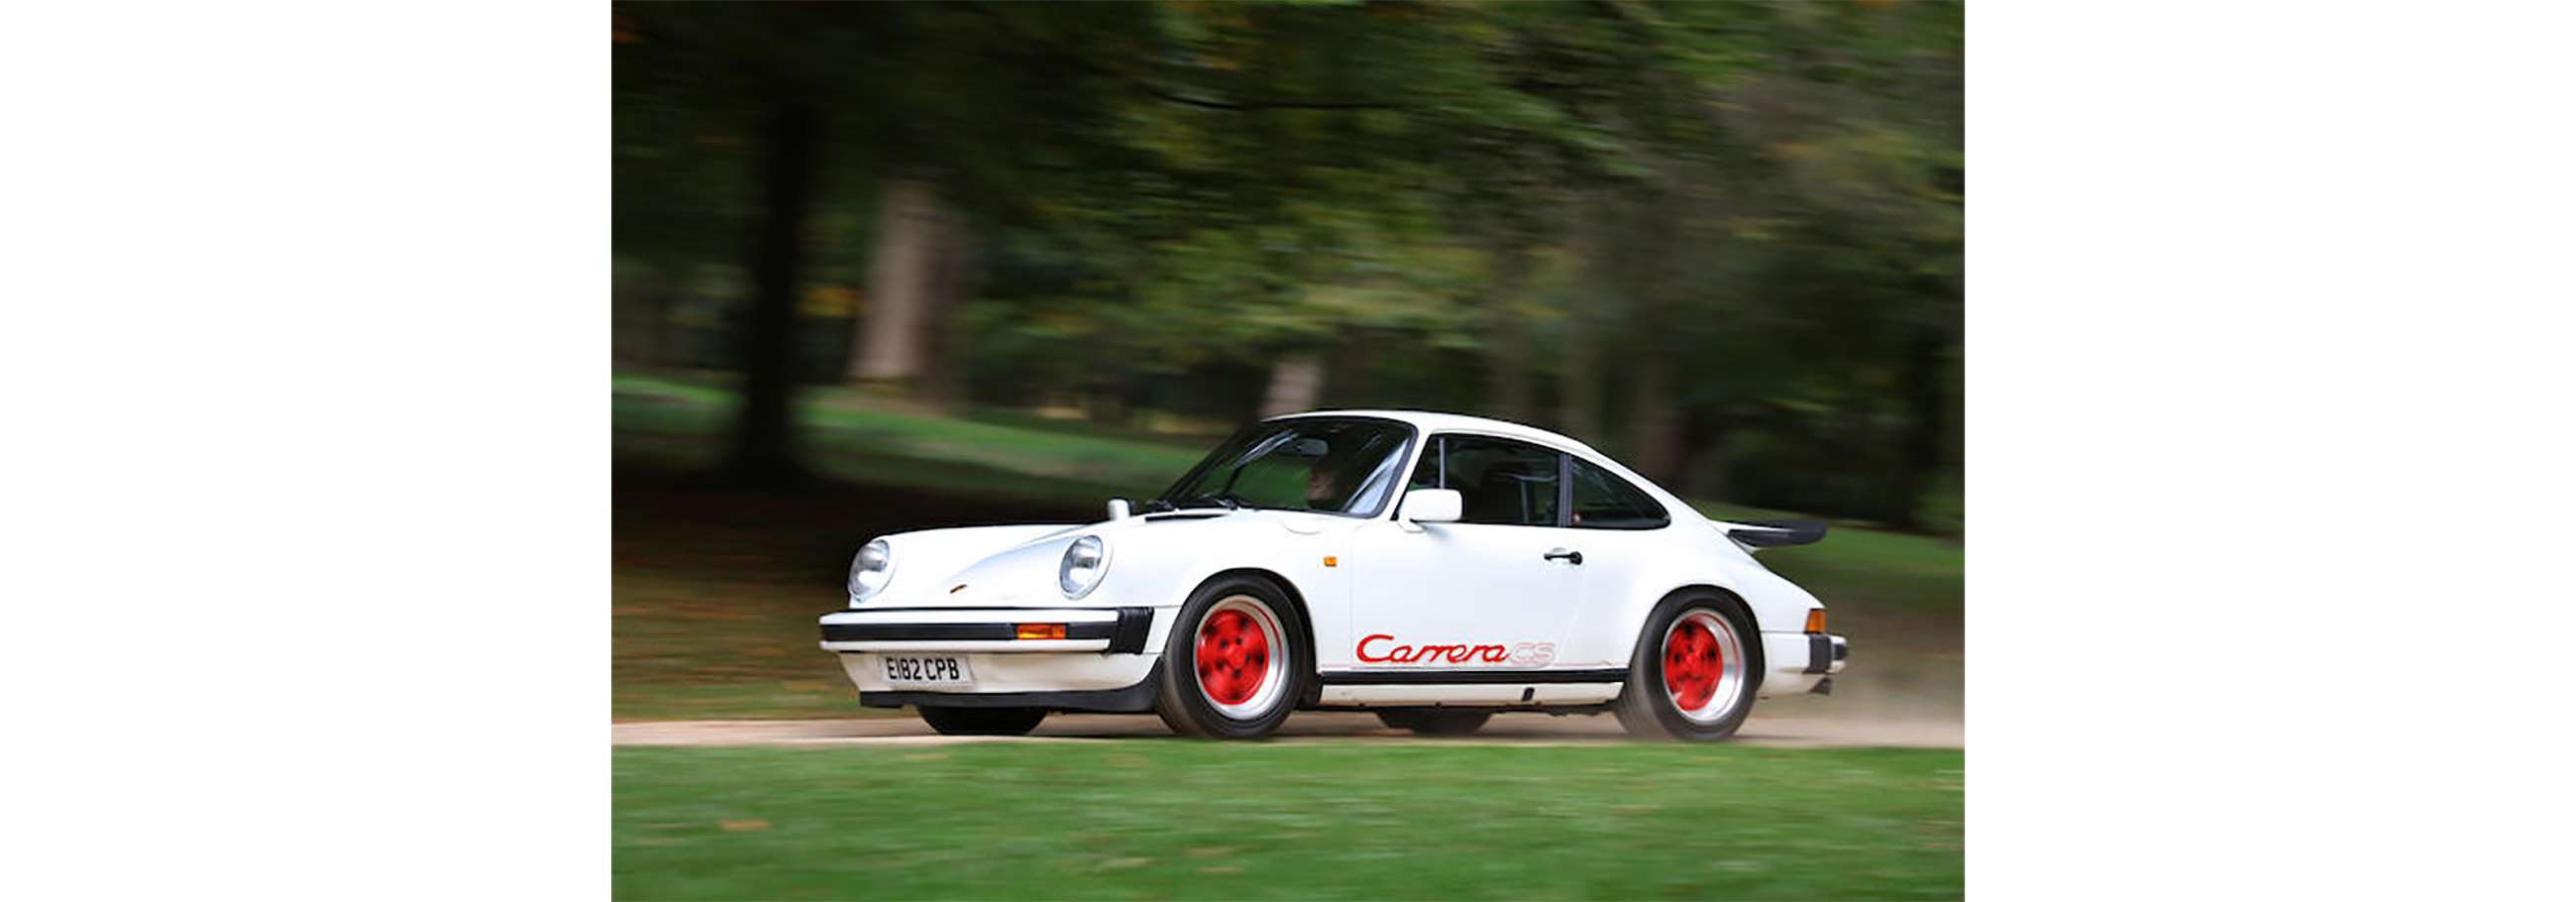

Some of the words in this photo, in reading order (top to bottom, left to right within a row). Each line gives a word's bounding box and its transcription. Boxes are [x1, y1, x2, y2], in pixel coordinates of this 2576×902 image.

[1356, 633, 1511, 664] Carrera
[1510, 641, 1556, 665] CS
[886, 656, 922, 681] E182
[923, 657, 960, 681] CPB
